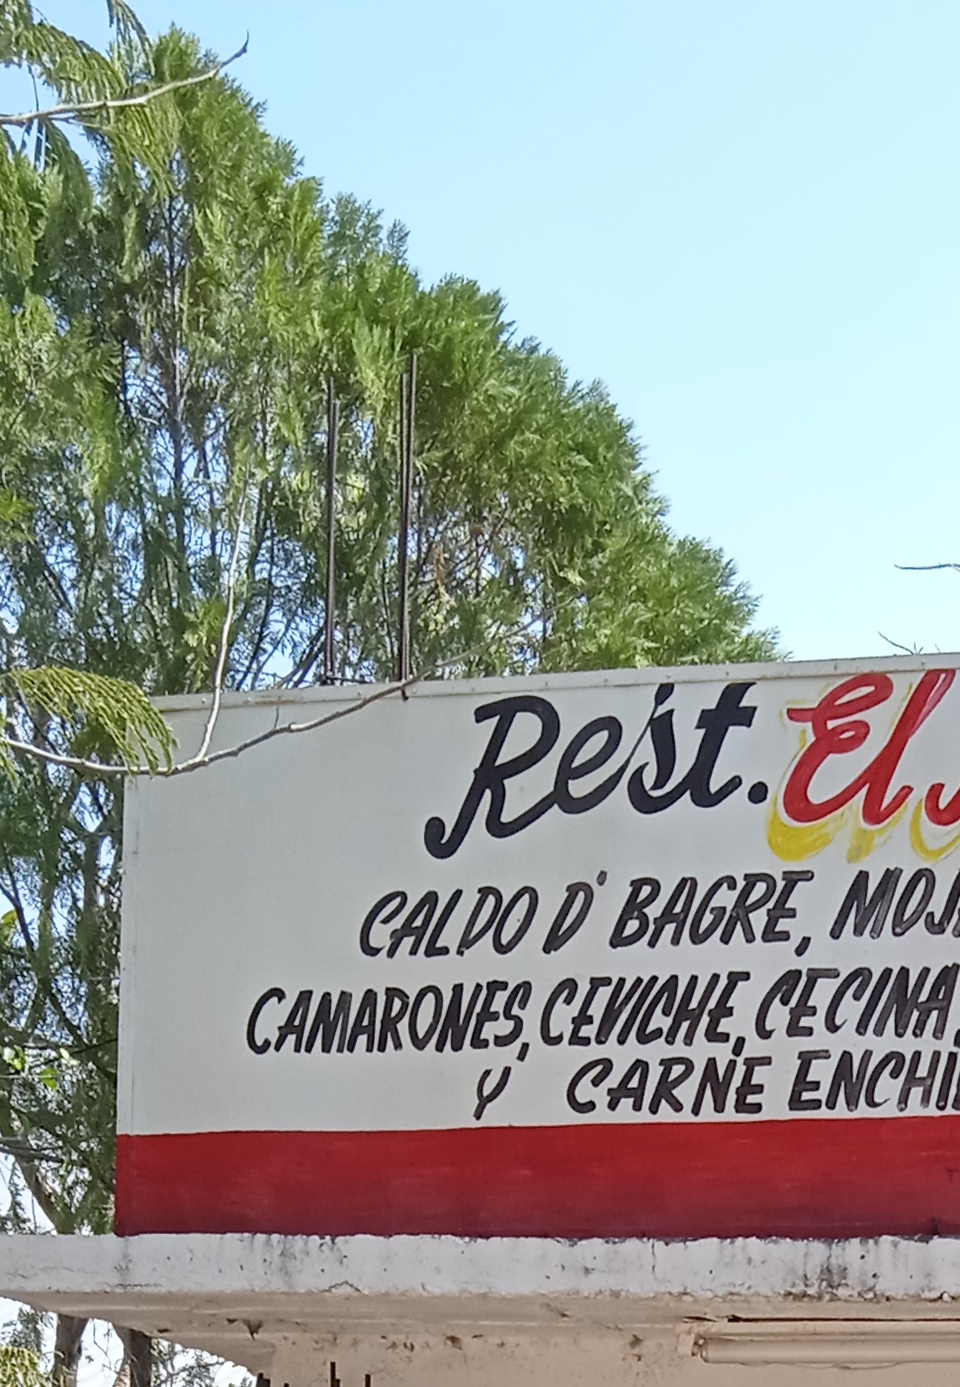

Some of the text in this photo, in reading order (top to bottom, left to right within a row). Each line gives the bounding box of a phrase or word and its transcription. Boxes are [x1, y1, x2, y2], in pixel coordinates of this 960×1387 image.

[424, 682, 768, 859] Rest.
[783, 668, 956, 826] El
[359, 886, 539, 958] CALDO
[542, 870, 607, 954] D'
[609, 870, 814, 957] BAGRE,
[246, 980, 532, 1061] CAMARONES,
[540, 971, 751, 1057] CEVICHE,
[566, 1056, 772, 1117] CARNE
